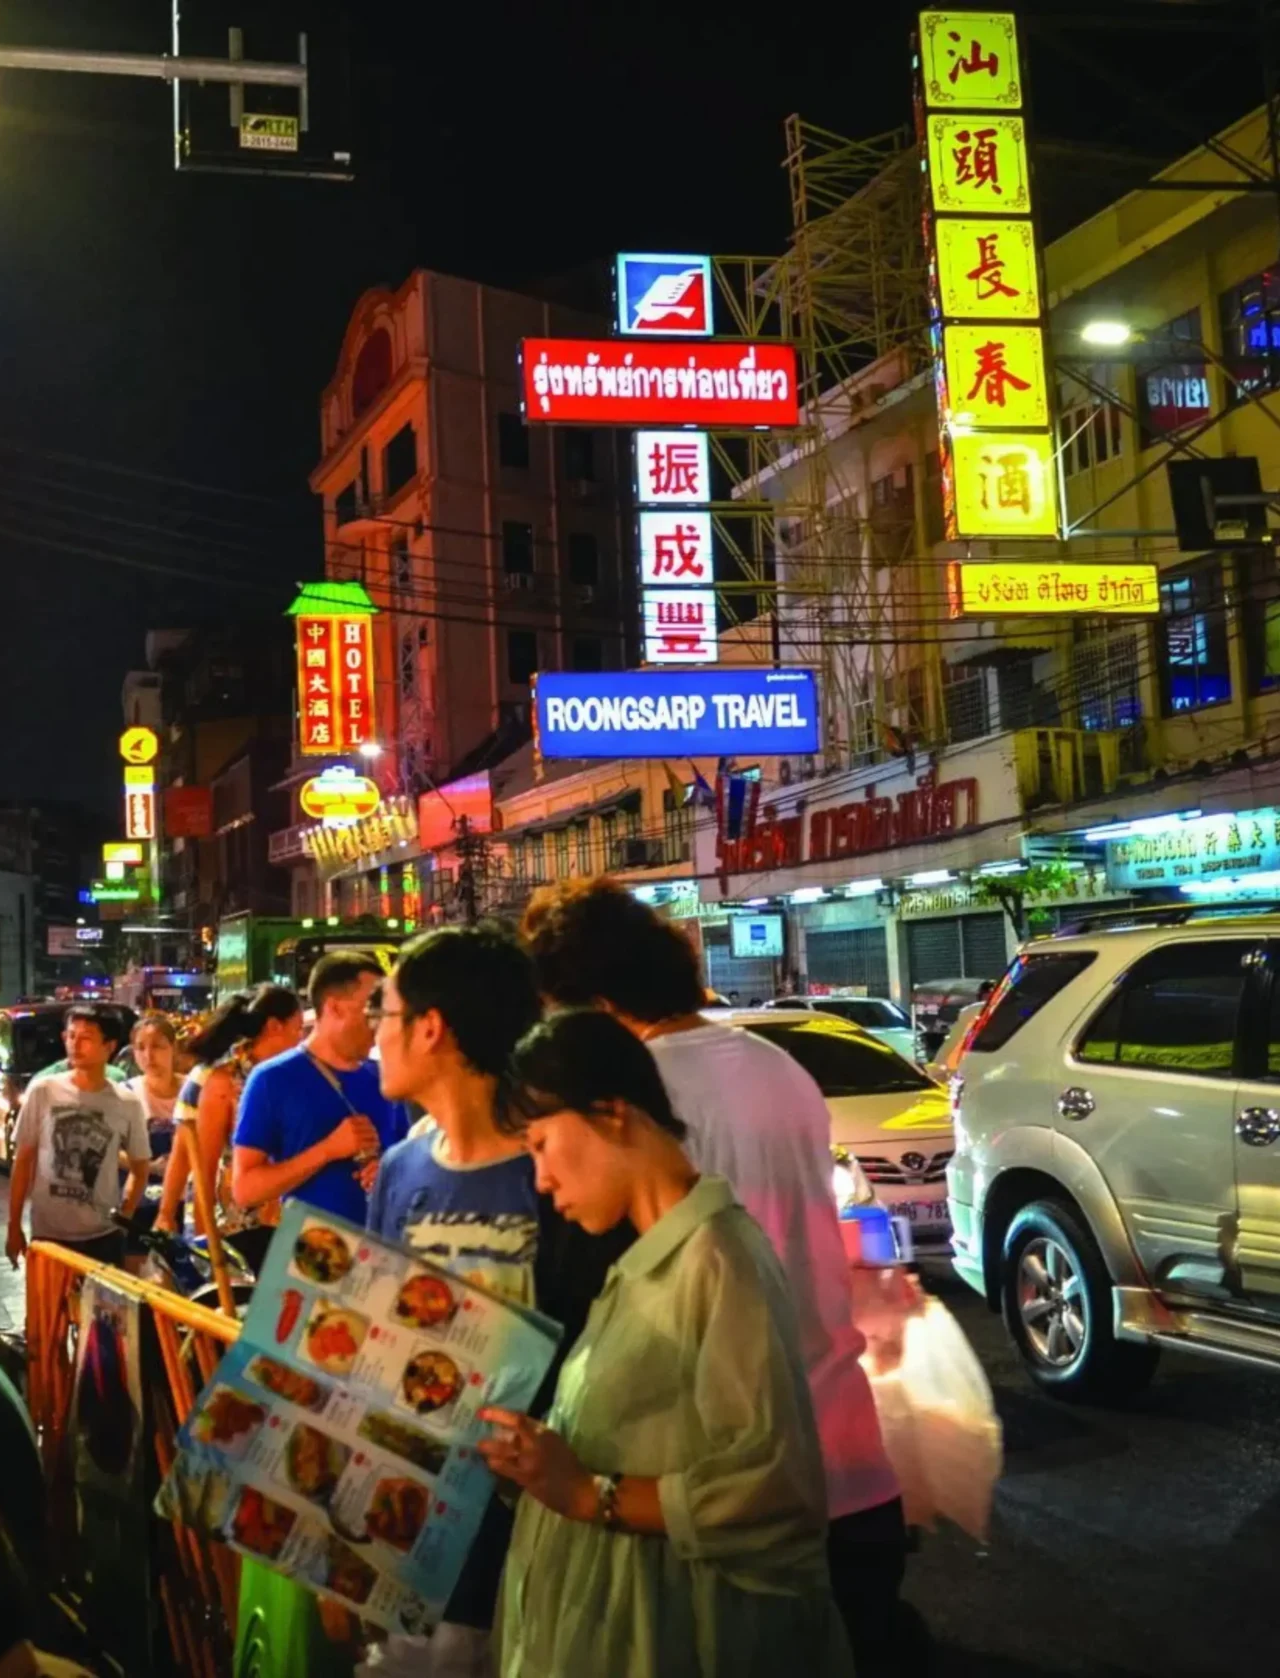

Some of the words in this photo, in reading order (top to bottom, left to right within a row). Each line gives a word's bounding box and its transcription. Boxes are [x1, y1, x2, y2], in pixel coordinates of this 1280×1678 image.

[647, 442, 708, 654] 振成豐
[305, 622, 331, 744] 中國大酒店
[344, 623, 364, 744] HOTEL
[546, 696, 706, 732] ROONGSARP
[711, 693, 808, 729] TRAVEL
